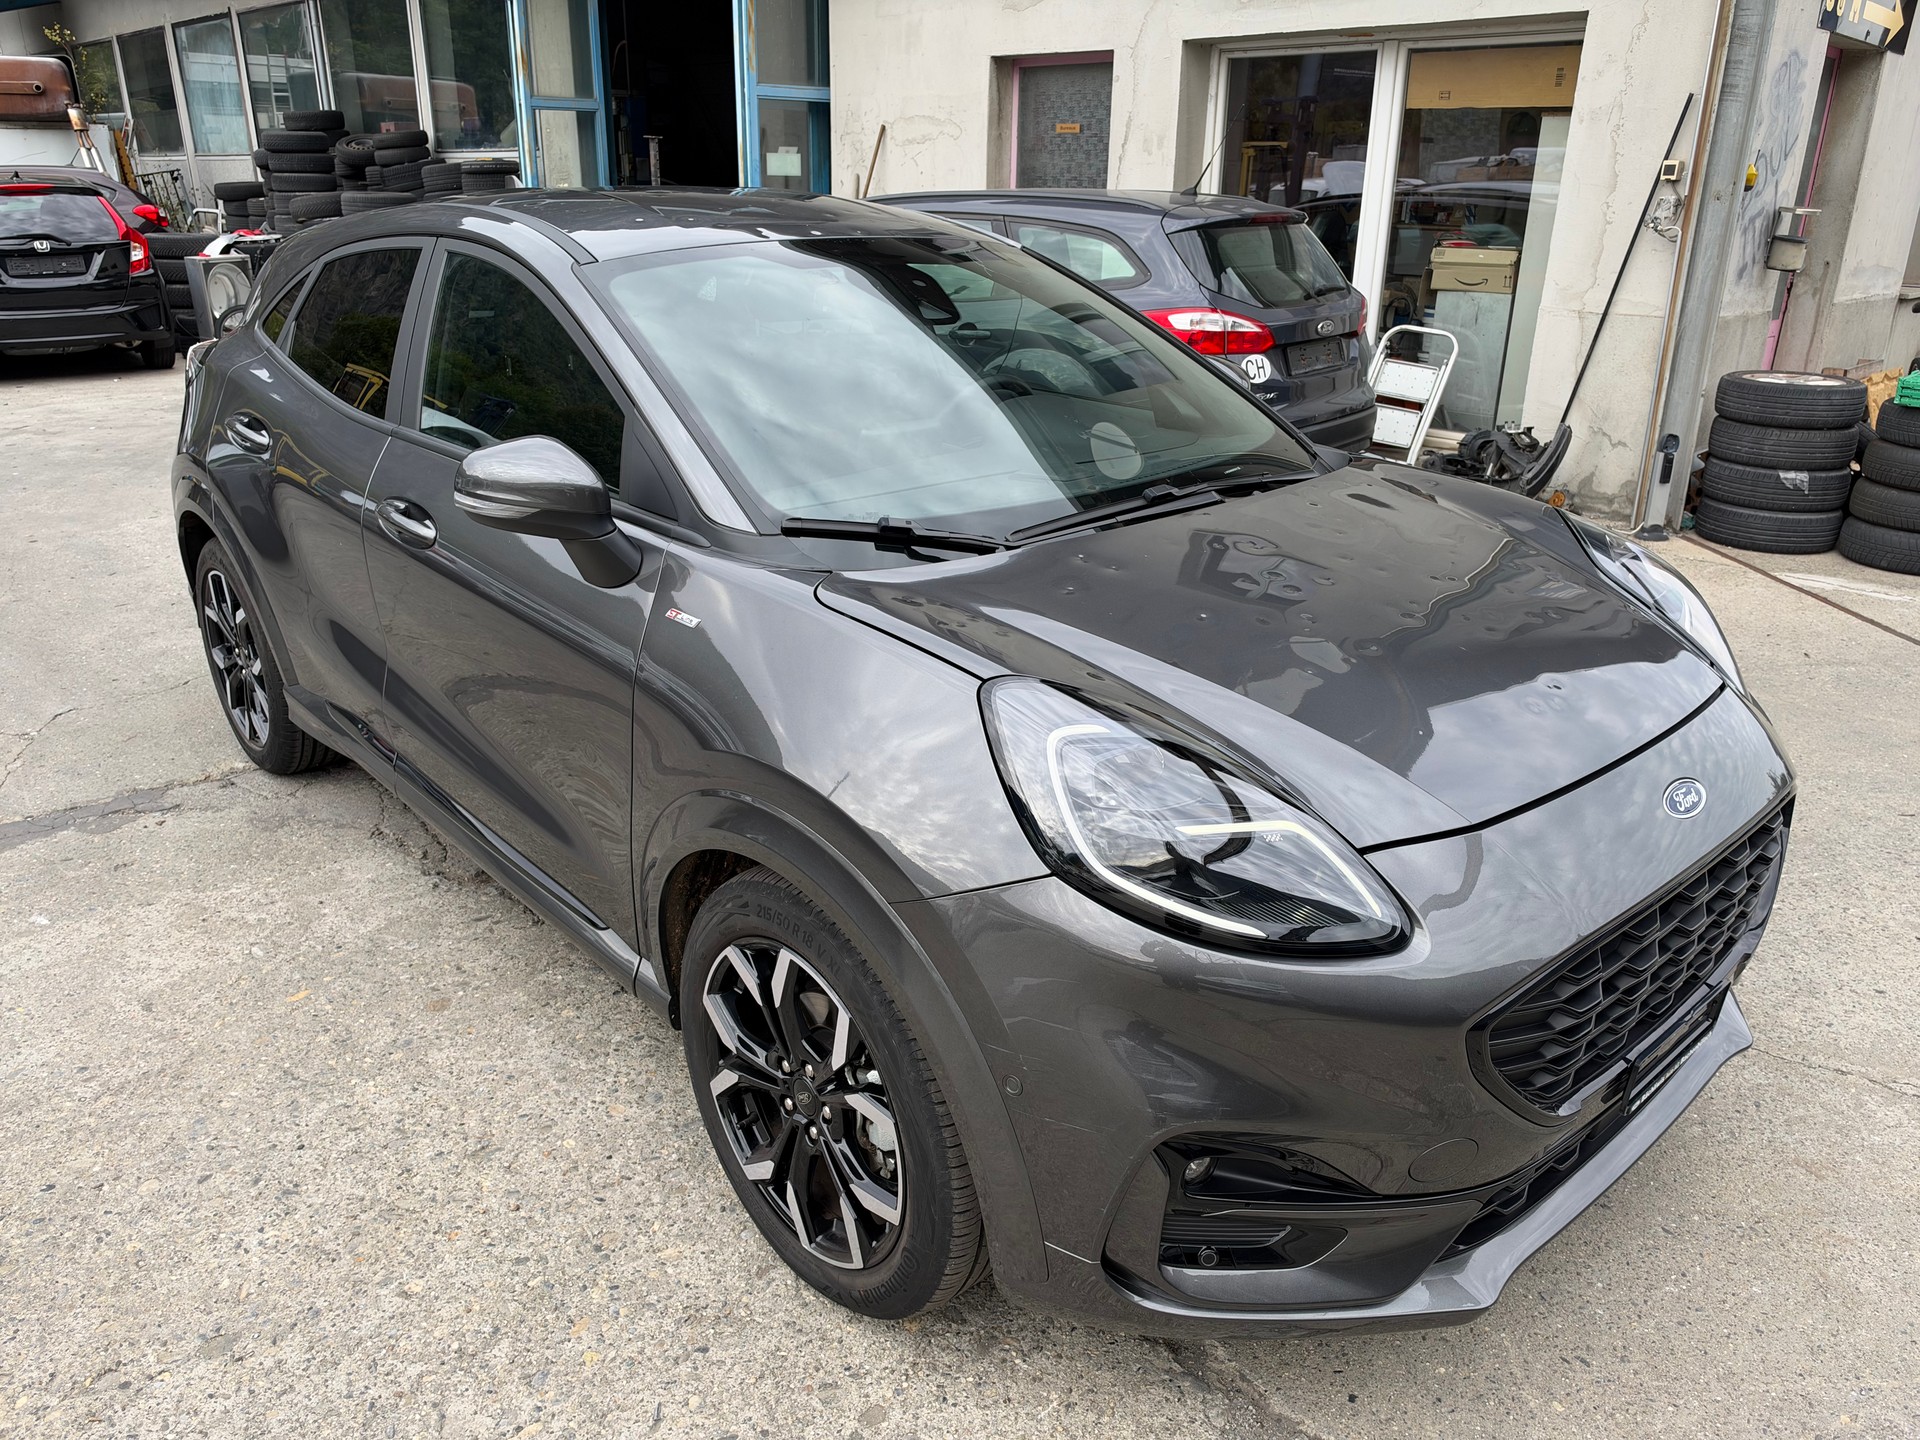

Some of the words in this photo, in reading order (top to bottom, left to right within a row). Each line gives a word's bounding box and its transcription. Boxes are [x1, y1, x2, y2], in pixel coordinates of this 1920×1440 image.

[1245, 358, 1267, 380] CH
[756, 903, 791, 931] 215/50
[791, 923, 801, 938] R
[802, 930, 814, 949] 18
[858, 1246, 918, 1309] Continental
